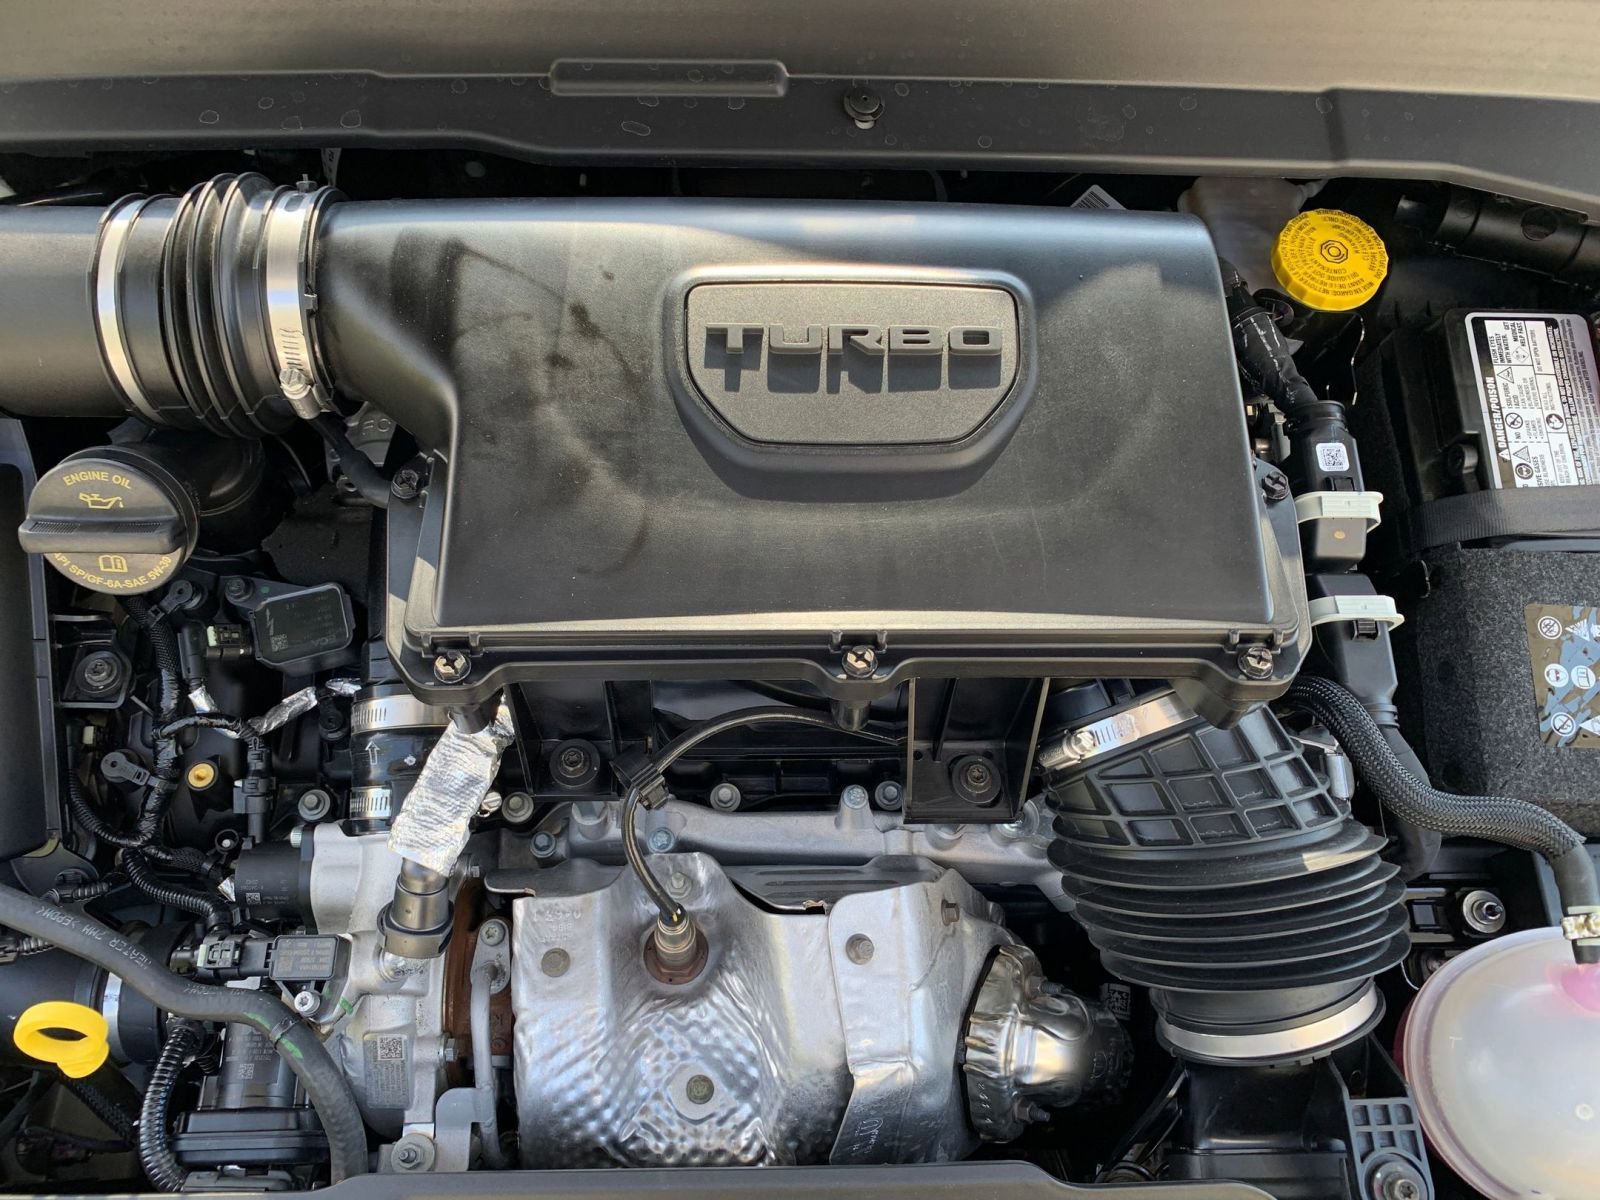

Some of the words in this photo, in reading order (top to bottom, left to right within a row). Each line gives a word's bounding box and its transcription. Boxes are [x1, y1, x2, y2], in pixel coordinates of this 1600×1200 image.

[705, 323, 1002, 355] TURBO
[1486, 377, 1508, 449] DANGER/POISON
[63, 471, 109, 486] ENGINE
[112, 474, 133, 489] OIL
[108, 936, 152, 969] HEATER
